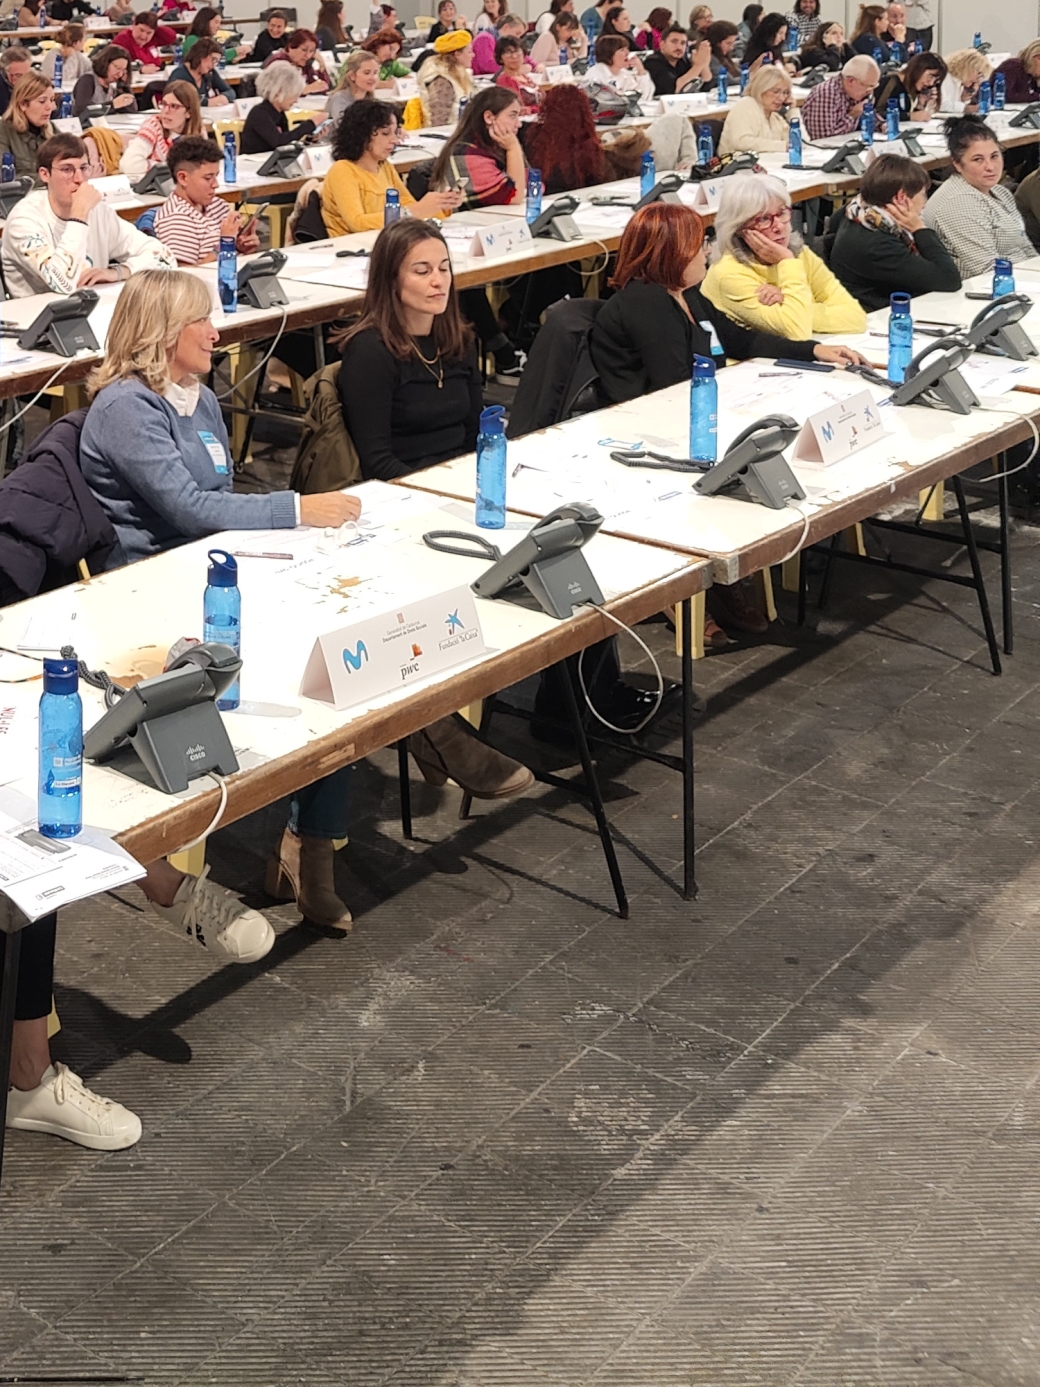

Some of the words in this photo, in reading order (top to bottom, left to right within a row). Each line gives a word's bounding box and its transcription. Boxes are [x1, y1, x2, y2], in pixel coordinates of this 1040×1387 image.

[438, 637, 460, 651] Fundació
[400, 661, 420, 680] pwc
[189, 751, 206, 762] CISCO
